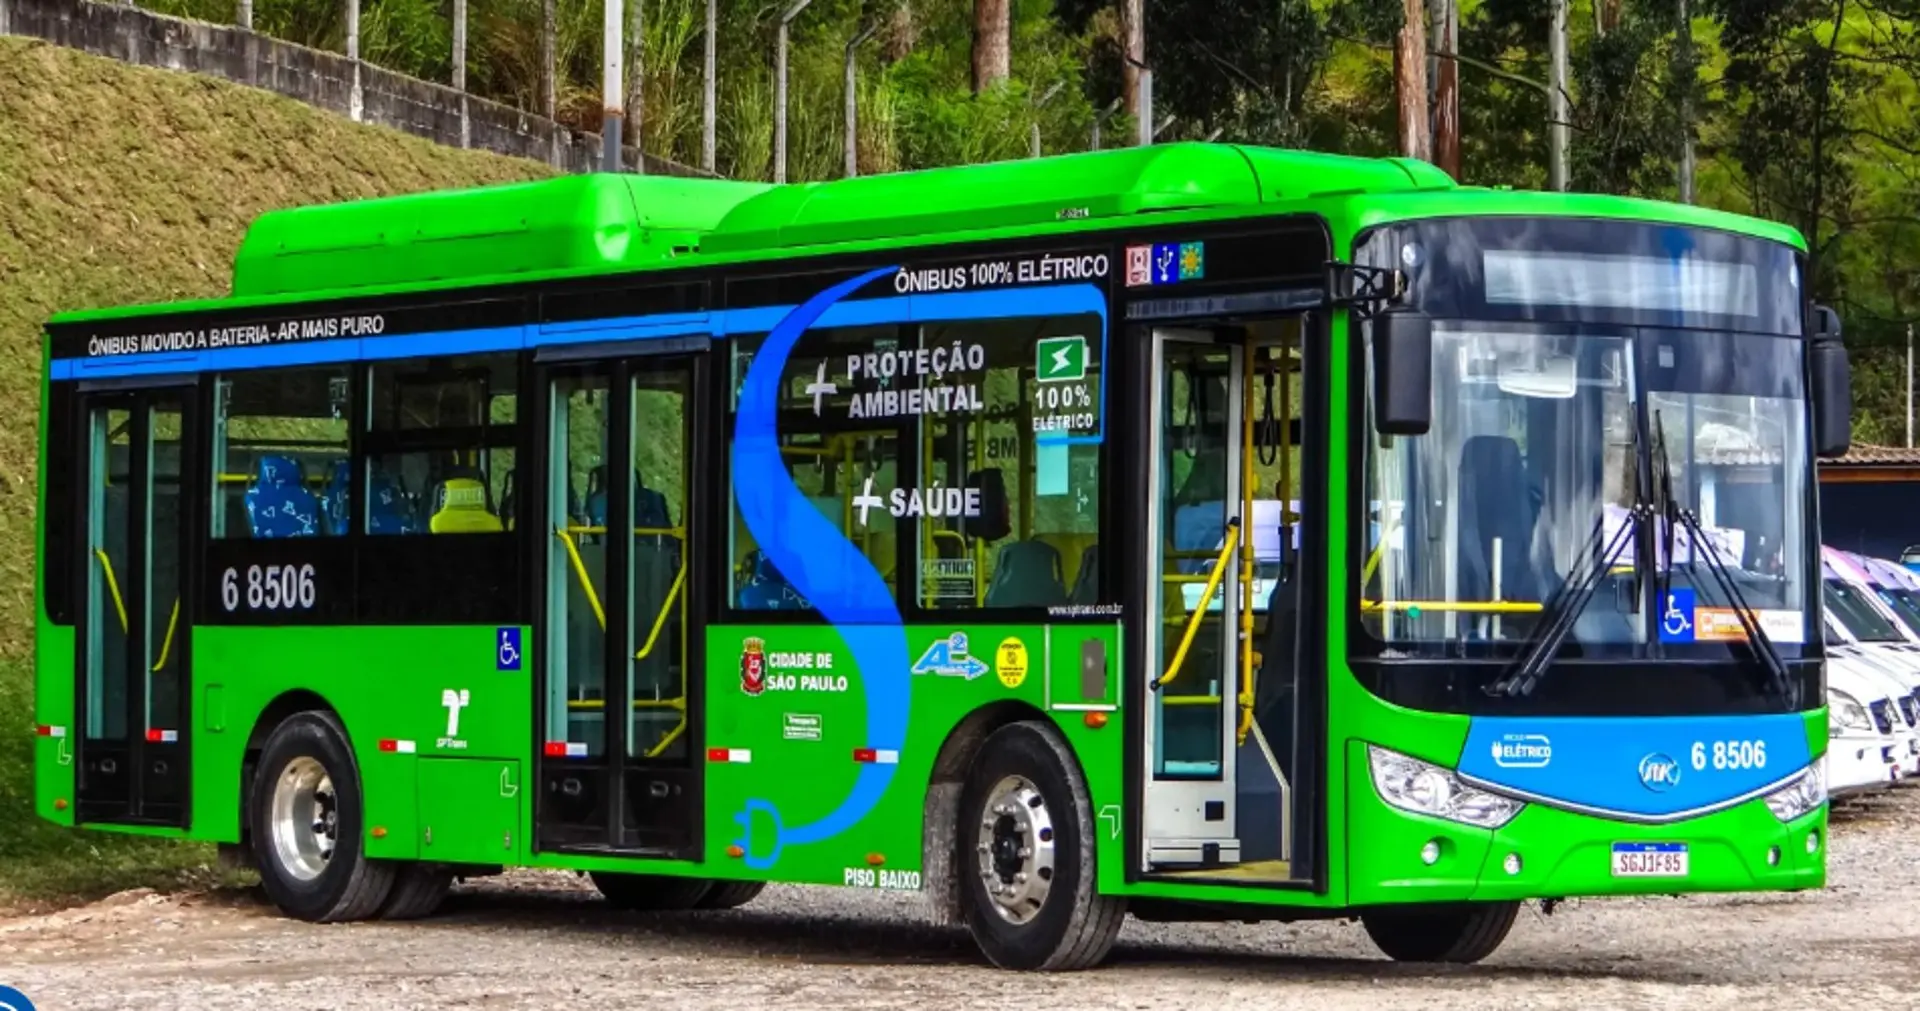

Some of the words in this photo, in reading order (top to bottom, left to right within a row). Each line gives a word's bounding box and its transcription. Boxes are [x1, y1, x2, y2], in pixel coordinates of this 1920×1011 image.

[892, 266, 967, 294] ÔNIBUS
[969, 261, 1014, 286] 100%
[1017, 253, 1109, 283] ELÉTRICO
[88, 334, 139, 356] ÔNIBUS
[140, 331, 195, 352] MOVIDO
[196, 329, 207, 349] A
[302, 318, 338, 338] MAIS
[340, 314, 385, 336] PURO
[847, 340, 985, 380] PROTEÇÃO
[848, 384, 984, 419] AMBIENTAL
[1035, 384, 1092, 409] 100%
[1032, 411, 1094, 432] ELÉTRICO
[889, 480, 981, 518] SAÚDE
[222, 566, 239, 612] 6
[247, 563, 316, 609] 8506
[768, 652, 813, 669] CIDADE
[816, 652, 833, 669] DE
[766, 672, 797, 691] SÃO
[800, 675, 849, 691] PAULO
[1503, 742, 1552, 758] ELÉTRICO
[1691, 741, 1707, 770] 6
[1712, 739, 1767, 769] 8506
[1620, 852, 1681, 873] SGJ1F85
[844, 867, 876, 887] PISO
[879, 869, 920, 890] BAIXO
